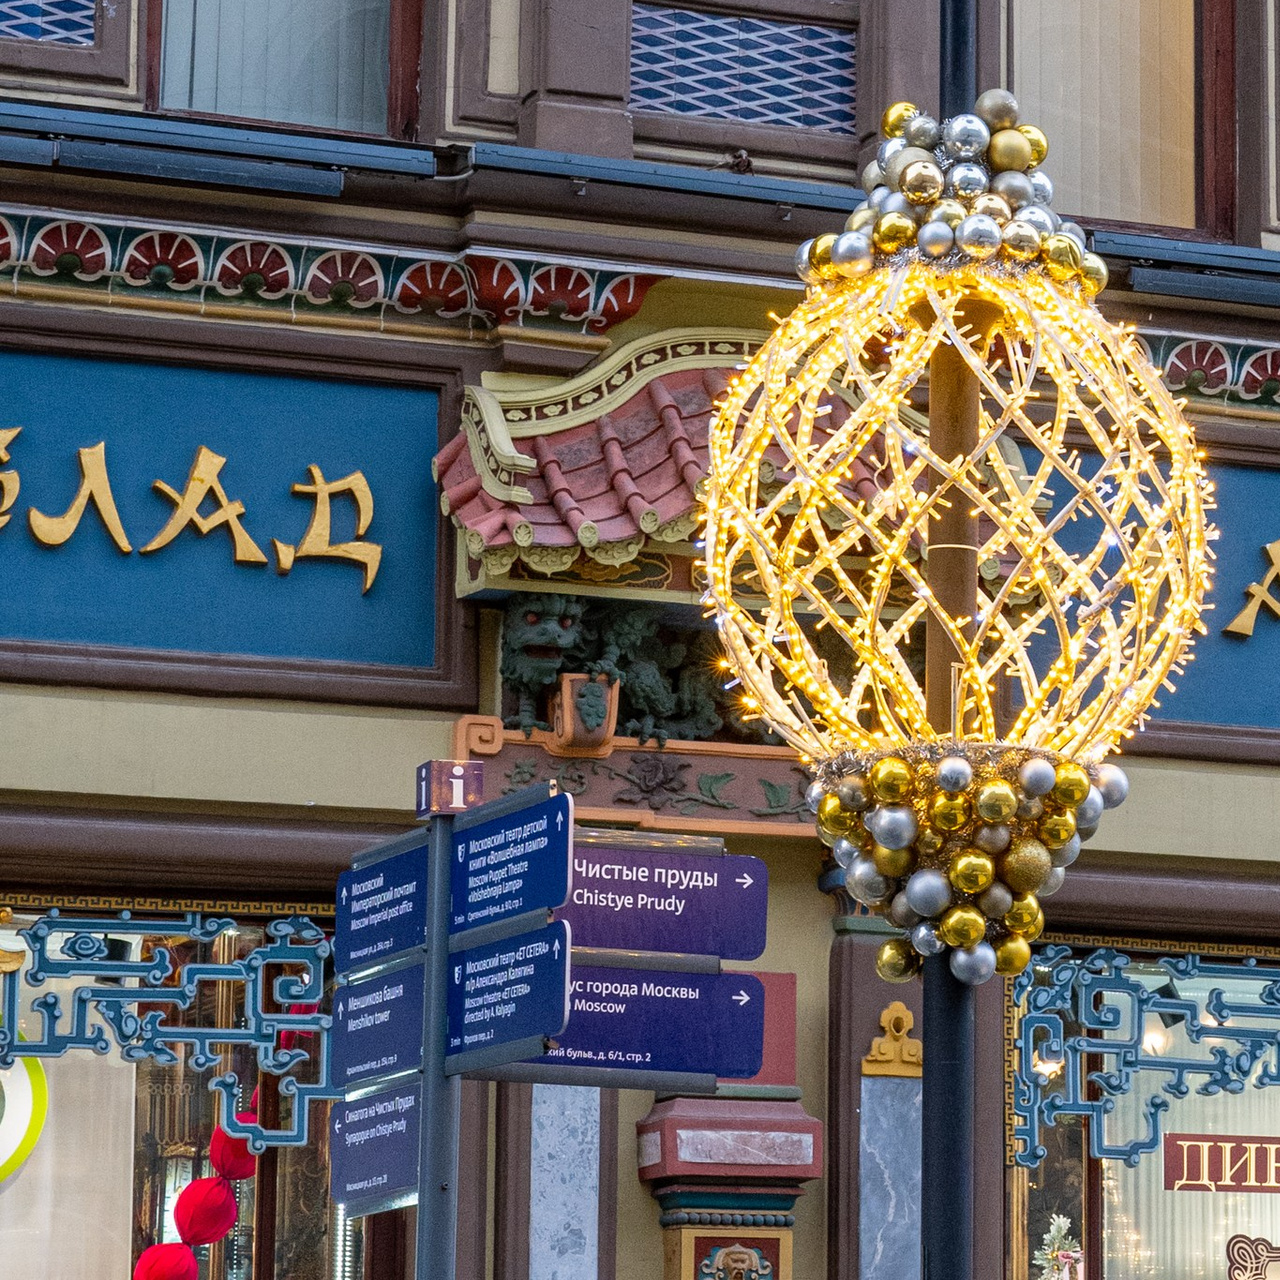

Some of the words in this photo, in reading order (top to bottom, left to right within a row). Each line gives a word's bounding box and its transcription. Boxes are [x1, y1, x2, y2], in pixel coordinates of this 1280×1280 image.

[0, 427, 383, 596] ЛАД
[448, 765, 468, 808] i
[469, 829, 505, 854] Московский
[505, 827, 522, 842] театр
[523, 815, 547, 839] детской
[469, 856, 486, 871] книги
[487, 843, 524, 864] «Волшебная
[525, 837, 548, 853] лампа»
[352, 873, 384, 897] Московский
[468, 874, 488, 889] Moscow
[489, 866, 507, 883] Puppet
[508, 861, 528, 876] Theatre
[574, 858, 649, 881] Чистые
[654, 868, 718, 889] пруды
[351, 886, 394, 914] Императорский
[573, 889, 633, 911] Chistye
[638, 894, 685, 915] Prudy
[351, 919, 369, 931] Moscow
[388, 906, 399, 922] post
[399, 900, 413, 915] office
[466, 953, 499, 975] Московский
[500, 952, 516, 966] театр
[475, 971, 508, 989] Александра
[508, 964, 535, 981] Калягина
[348, 991, 383, 1012] Меншикова
[383, 985, 404, 1002] башня
[465, 997, 483, 1010] Moscow
[484, 992, 501, 1005] theatre
[586, 981, 638, 997] города
[641, 983, 699, 999] Москвы
[464, 1007, 484, 1024] directed
[496, 1001, 516, 1018] Kalyagin
[574, 998, 626, 1013] Moscow
[348, 1013, 375, 1032] Menshikov
[375, 1010, 391, 1025] tower
[626, 1053, 644, 1064] стр.
[645, 1053, 651, 1062] 2
[345, 1107, 368, 1124] Синагога
[368, 1105, 375, 1118] на
[375, 1101, 395, 1115] Чистых
[395, 1095, 415, 1113] Прудах
[345, 1129, 370, 1147] Synagogue
[369, 1127, 376, 1139] on
[376, 1122, 393, 1137] Chistye
[393, 1117, 407, 1133] Prudy
